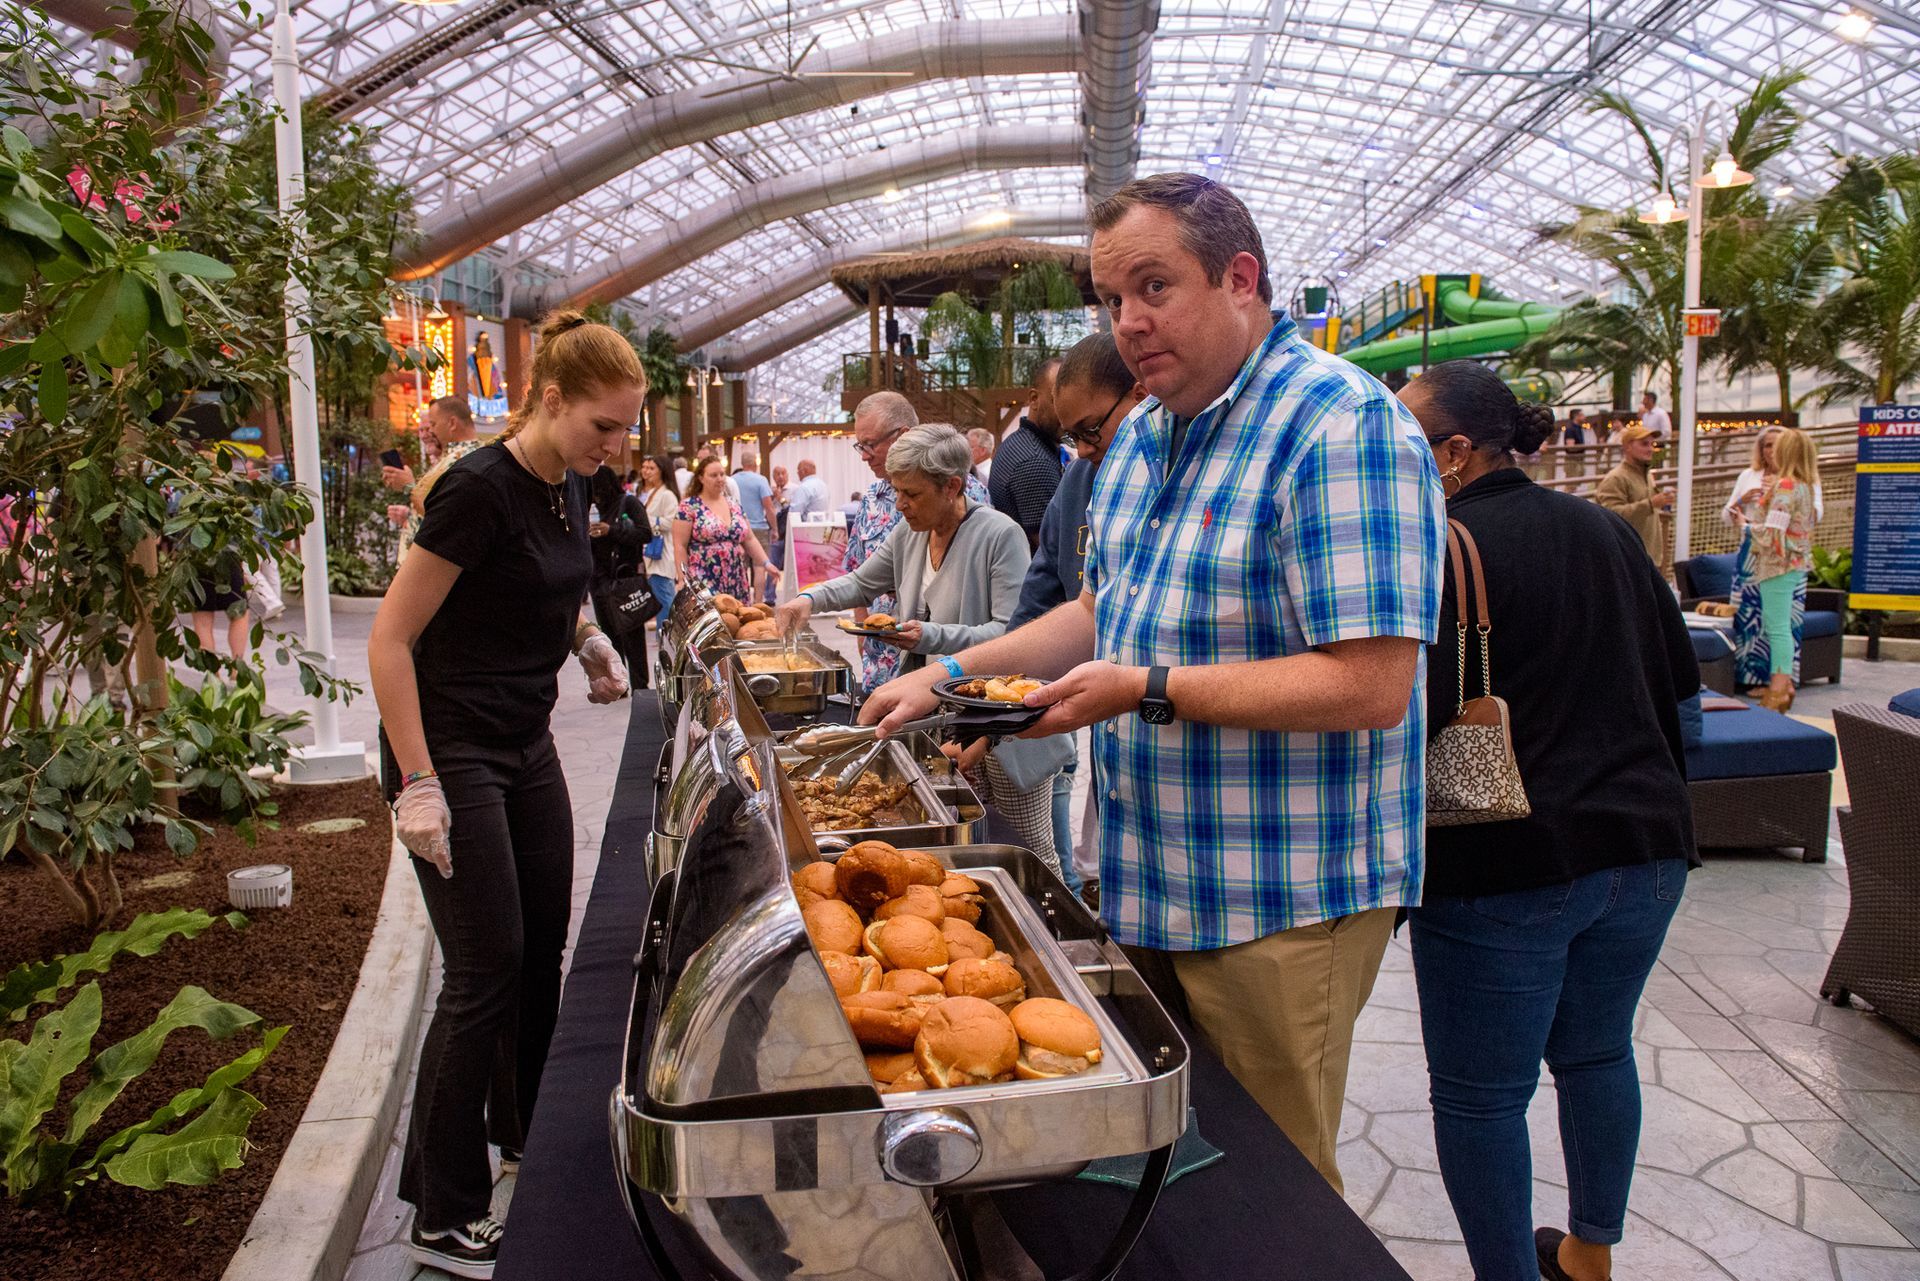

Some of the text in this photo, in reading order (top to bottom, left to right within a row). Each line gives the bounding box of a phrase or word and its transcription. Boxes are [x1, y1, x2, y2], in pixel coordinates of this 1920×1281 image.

[1873, 408, 1920, 420] KIDS C
[619, 599, 640, 611] TOTE
